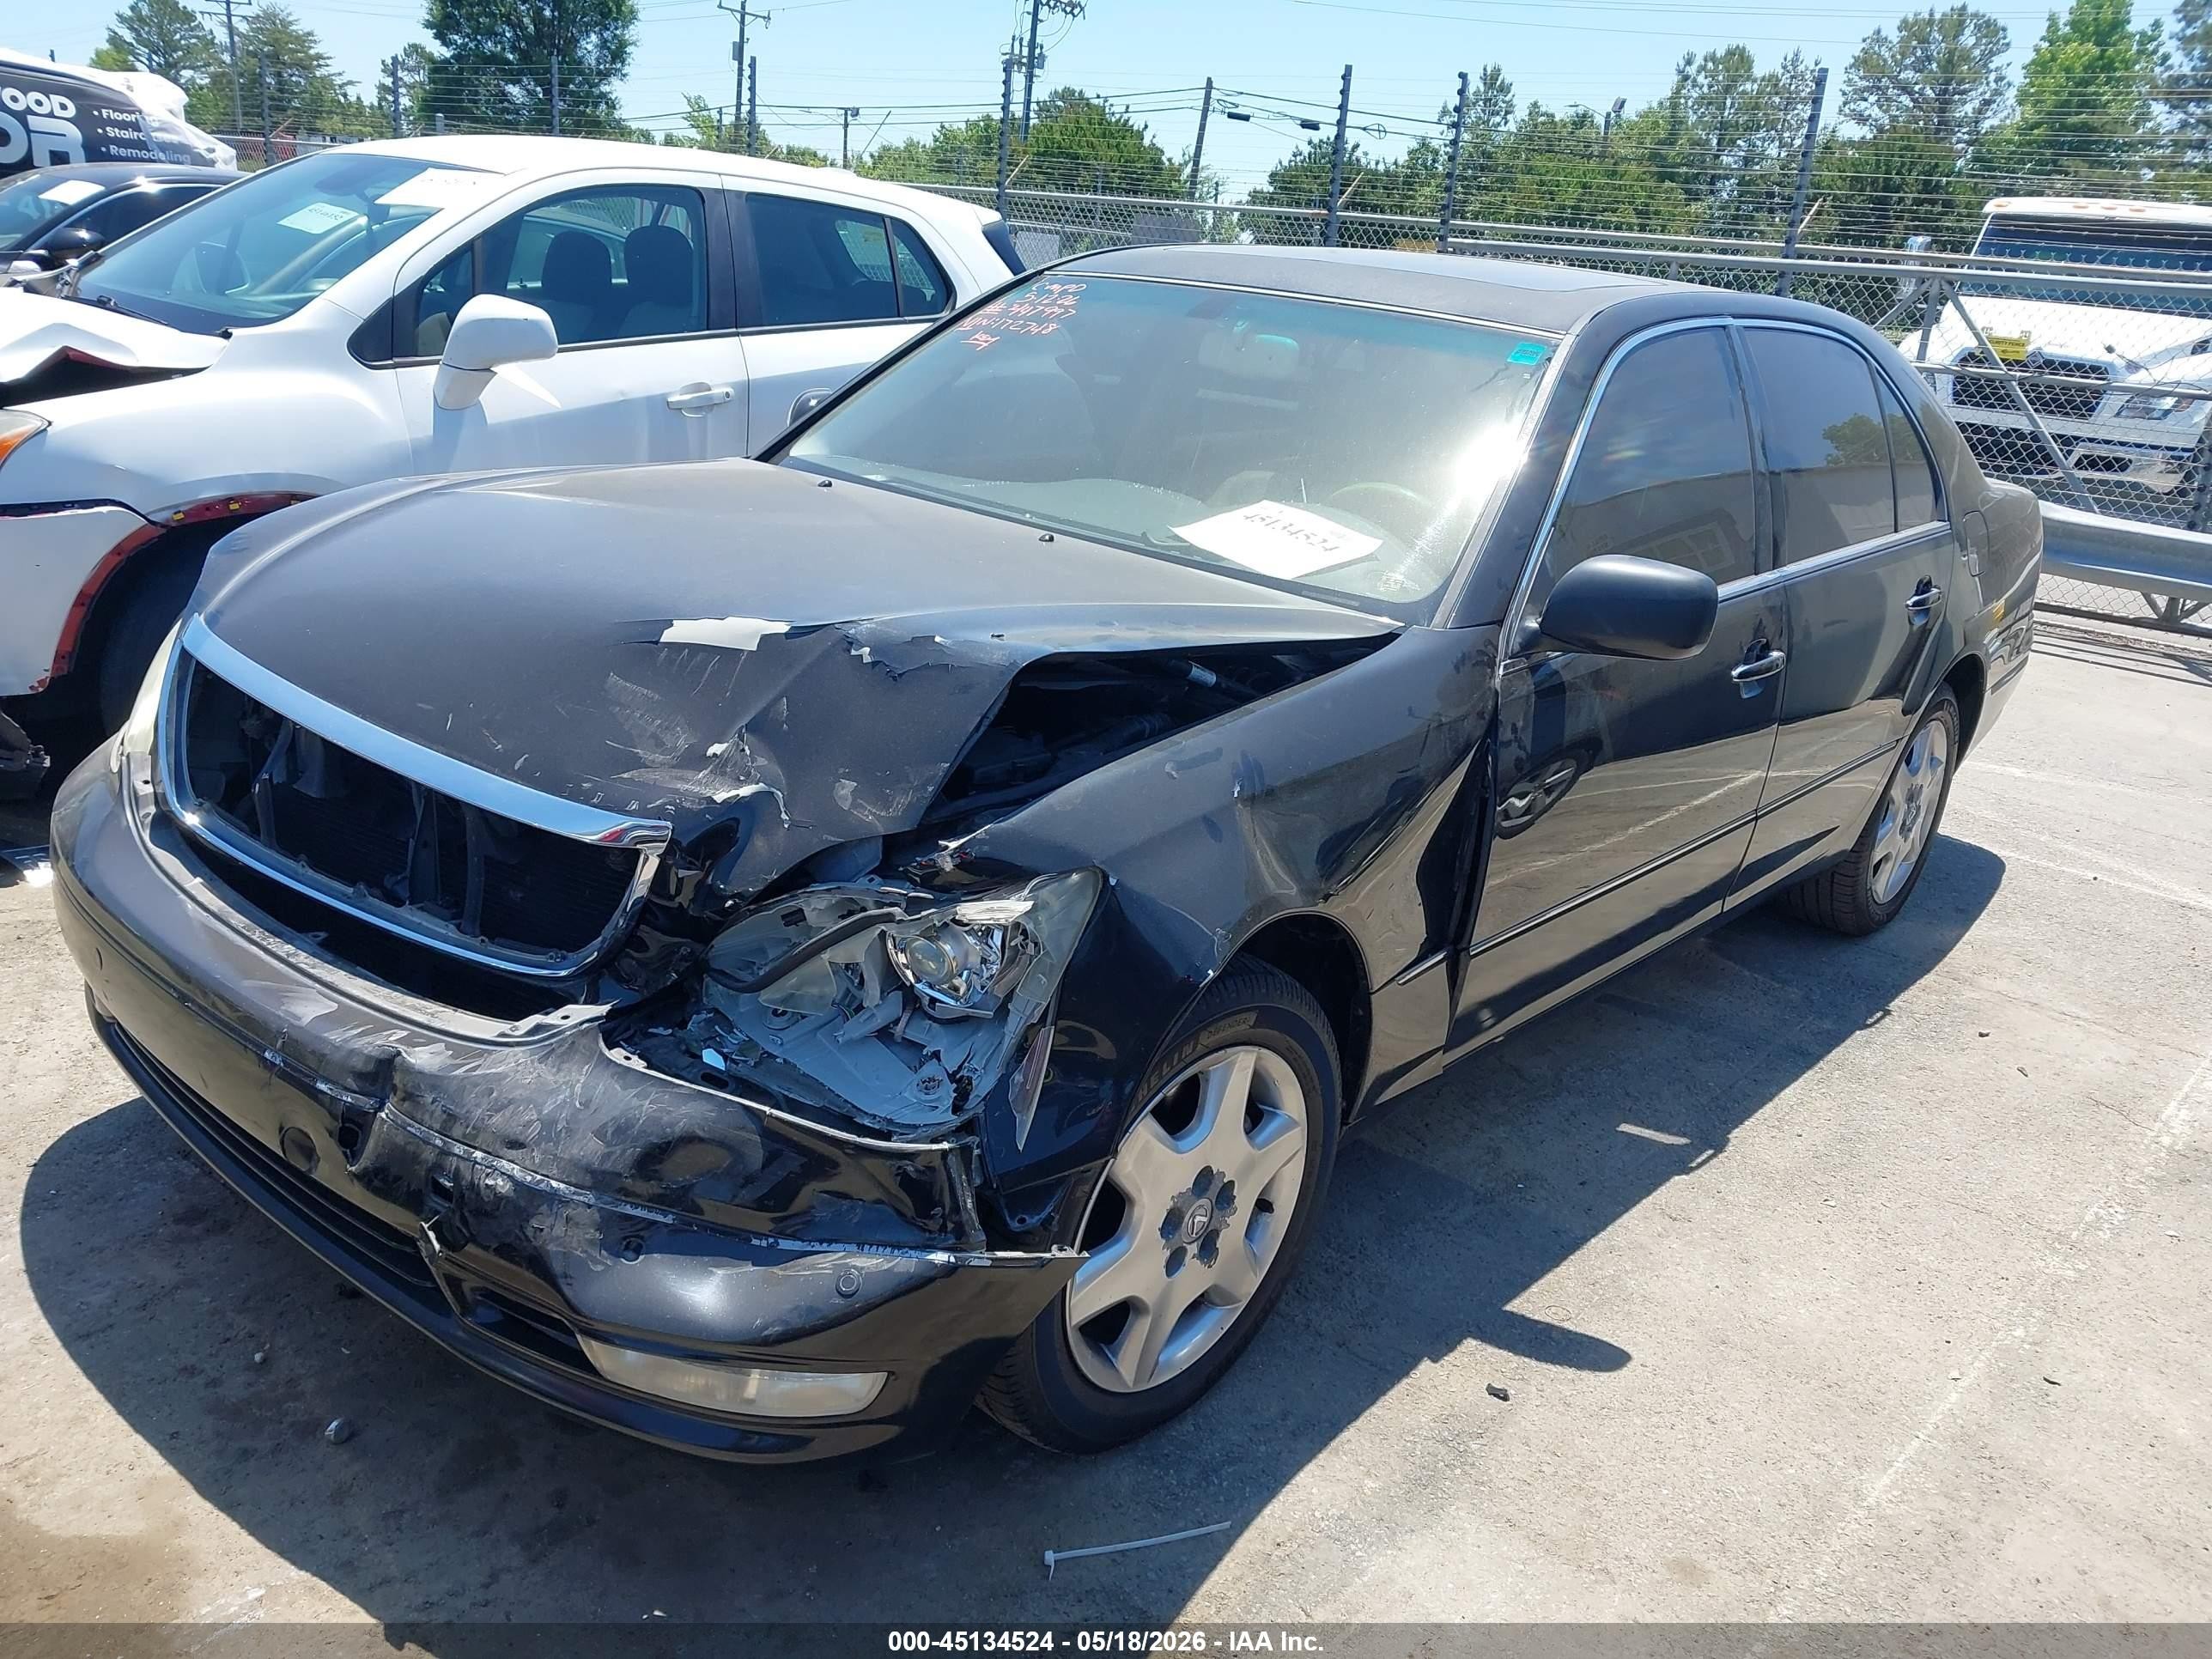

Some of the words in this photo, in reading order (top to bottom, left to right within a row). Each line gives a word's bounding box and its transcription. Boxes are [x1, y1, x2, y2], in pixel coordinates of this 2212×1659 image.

[0, 87, 76, 118] OOD
[100, 108, 159, 128] Floorig
[109, 144, 191, 166] Remodeling
